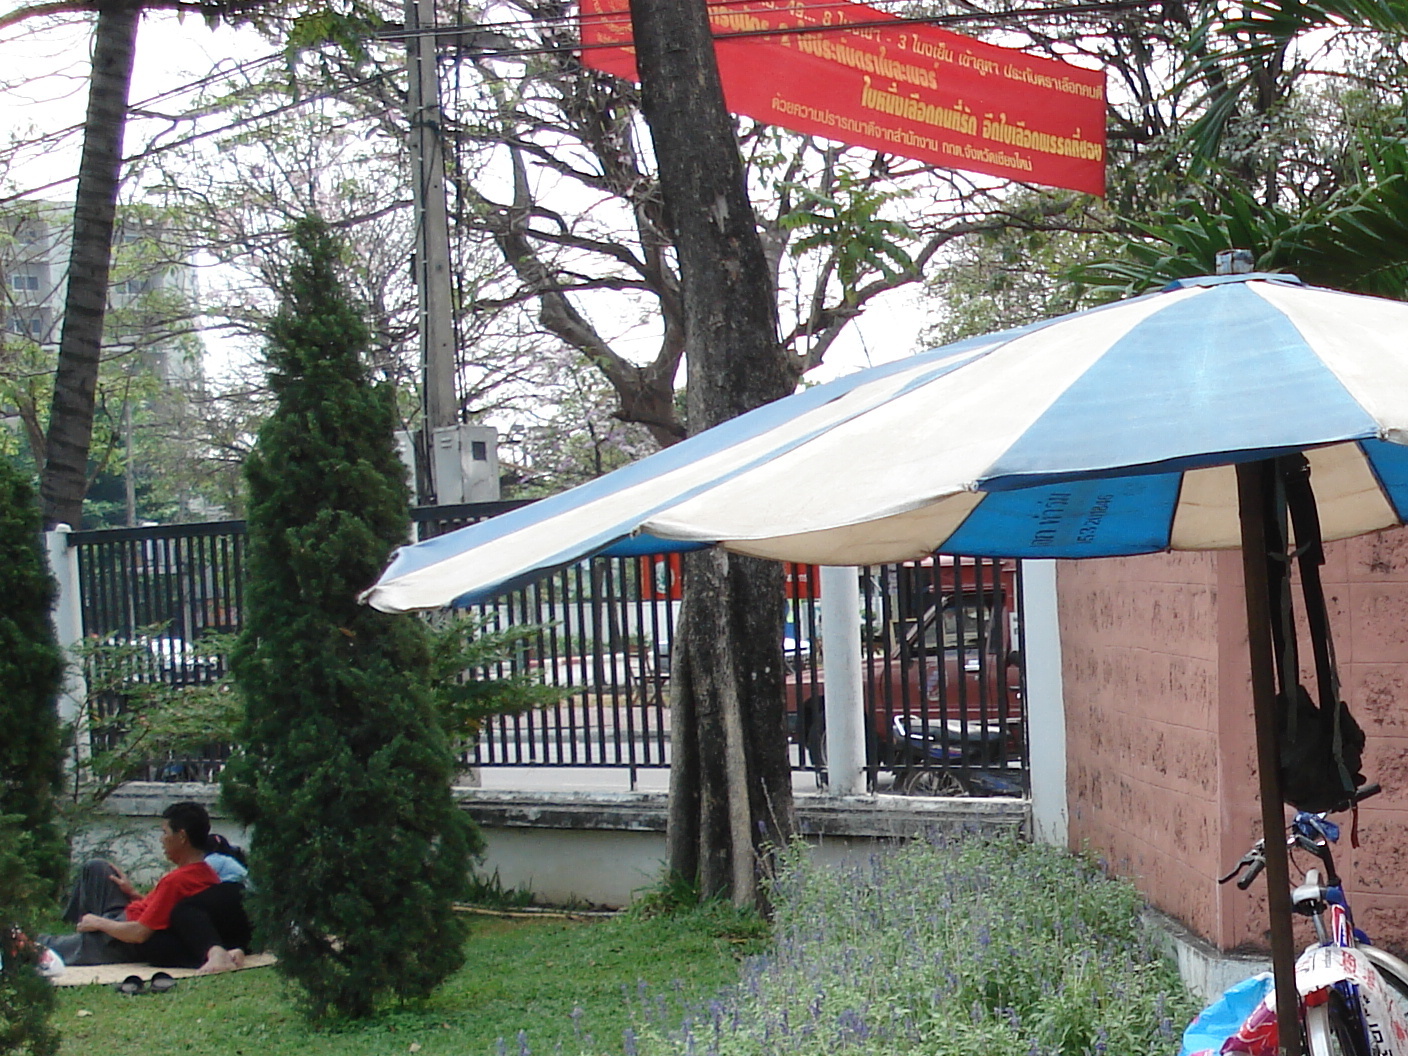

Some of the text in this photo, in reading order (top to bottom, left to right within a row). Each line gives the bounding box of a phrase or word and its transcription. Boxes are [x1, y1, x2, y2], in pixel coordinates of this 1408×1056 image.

[897, 36, 907, 50] 3
[912, 33, 954, 63] โมงเย็น
